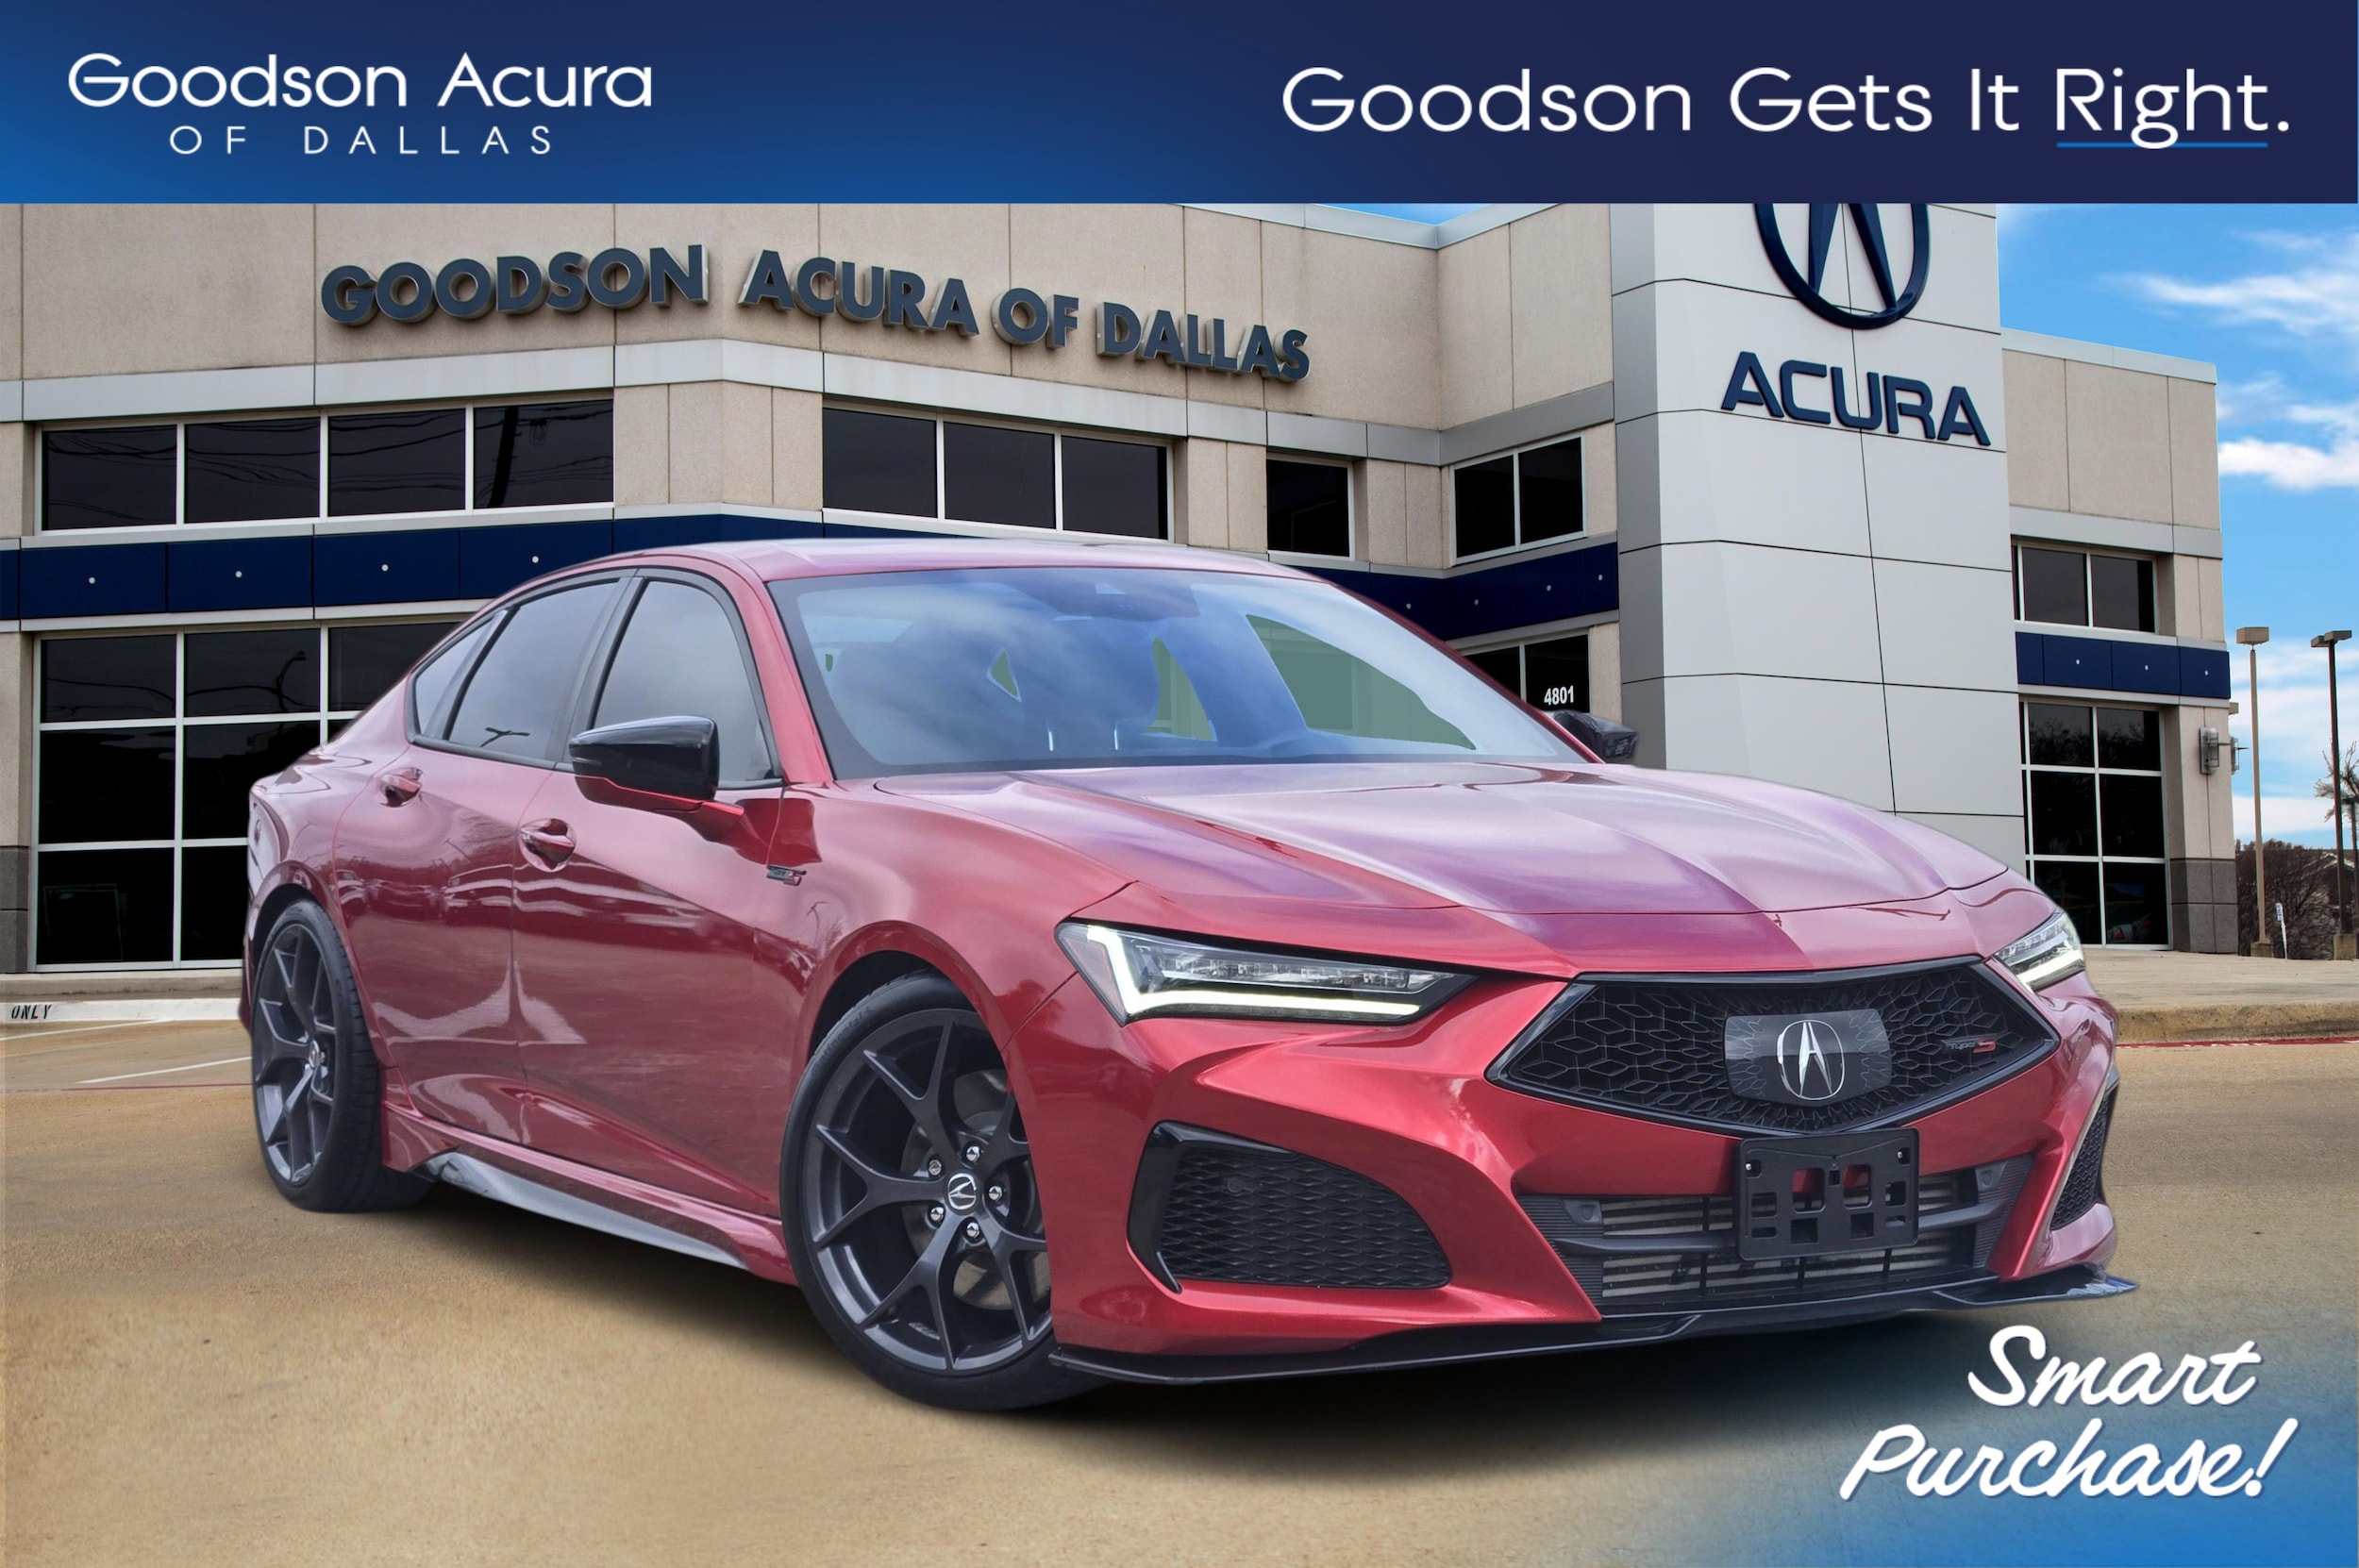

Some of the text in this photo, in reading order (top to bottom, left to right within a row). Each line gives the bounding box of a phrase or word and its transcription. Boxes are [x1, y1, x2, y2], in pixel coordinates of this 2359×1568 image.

[321, 244, 1311, 381] GOODSON ACURA OF DALLAS
[1720, 351, 1991, 446] ACURA
[1544, 685, 1574, 706] 4801
[11, 1004, 52, 1020] ONLY
[1973, 1037, 1997, 1054] S
